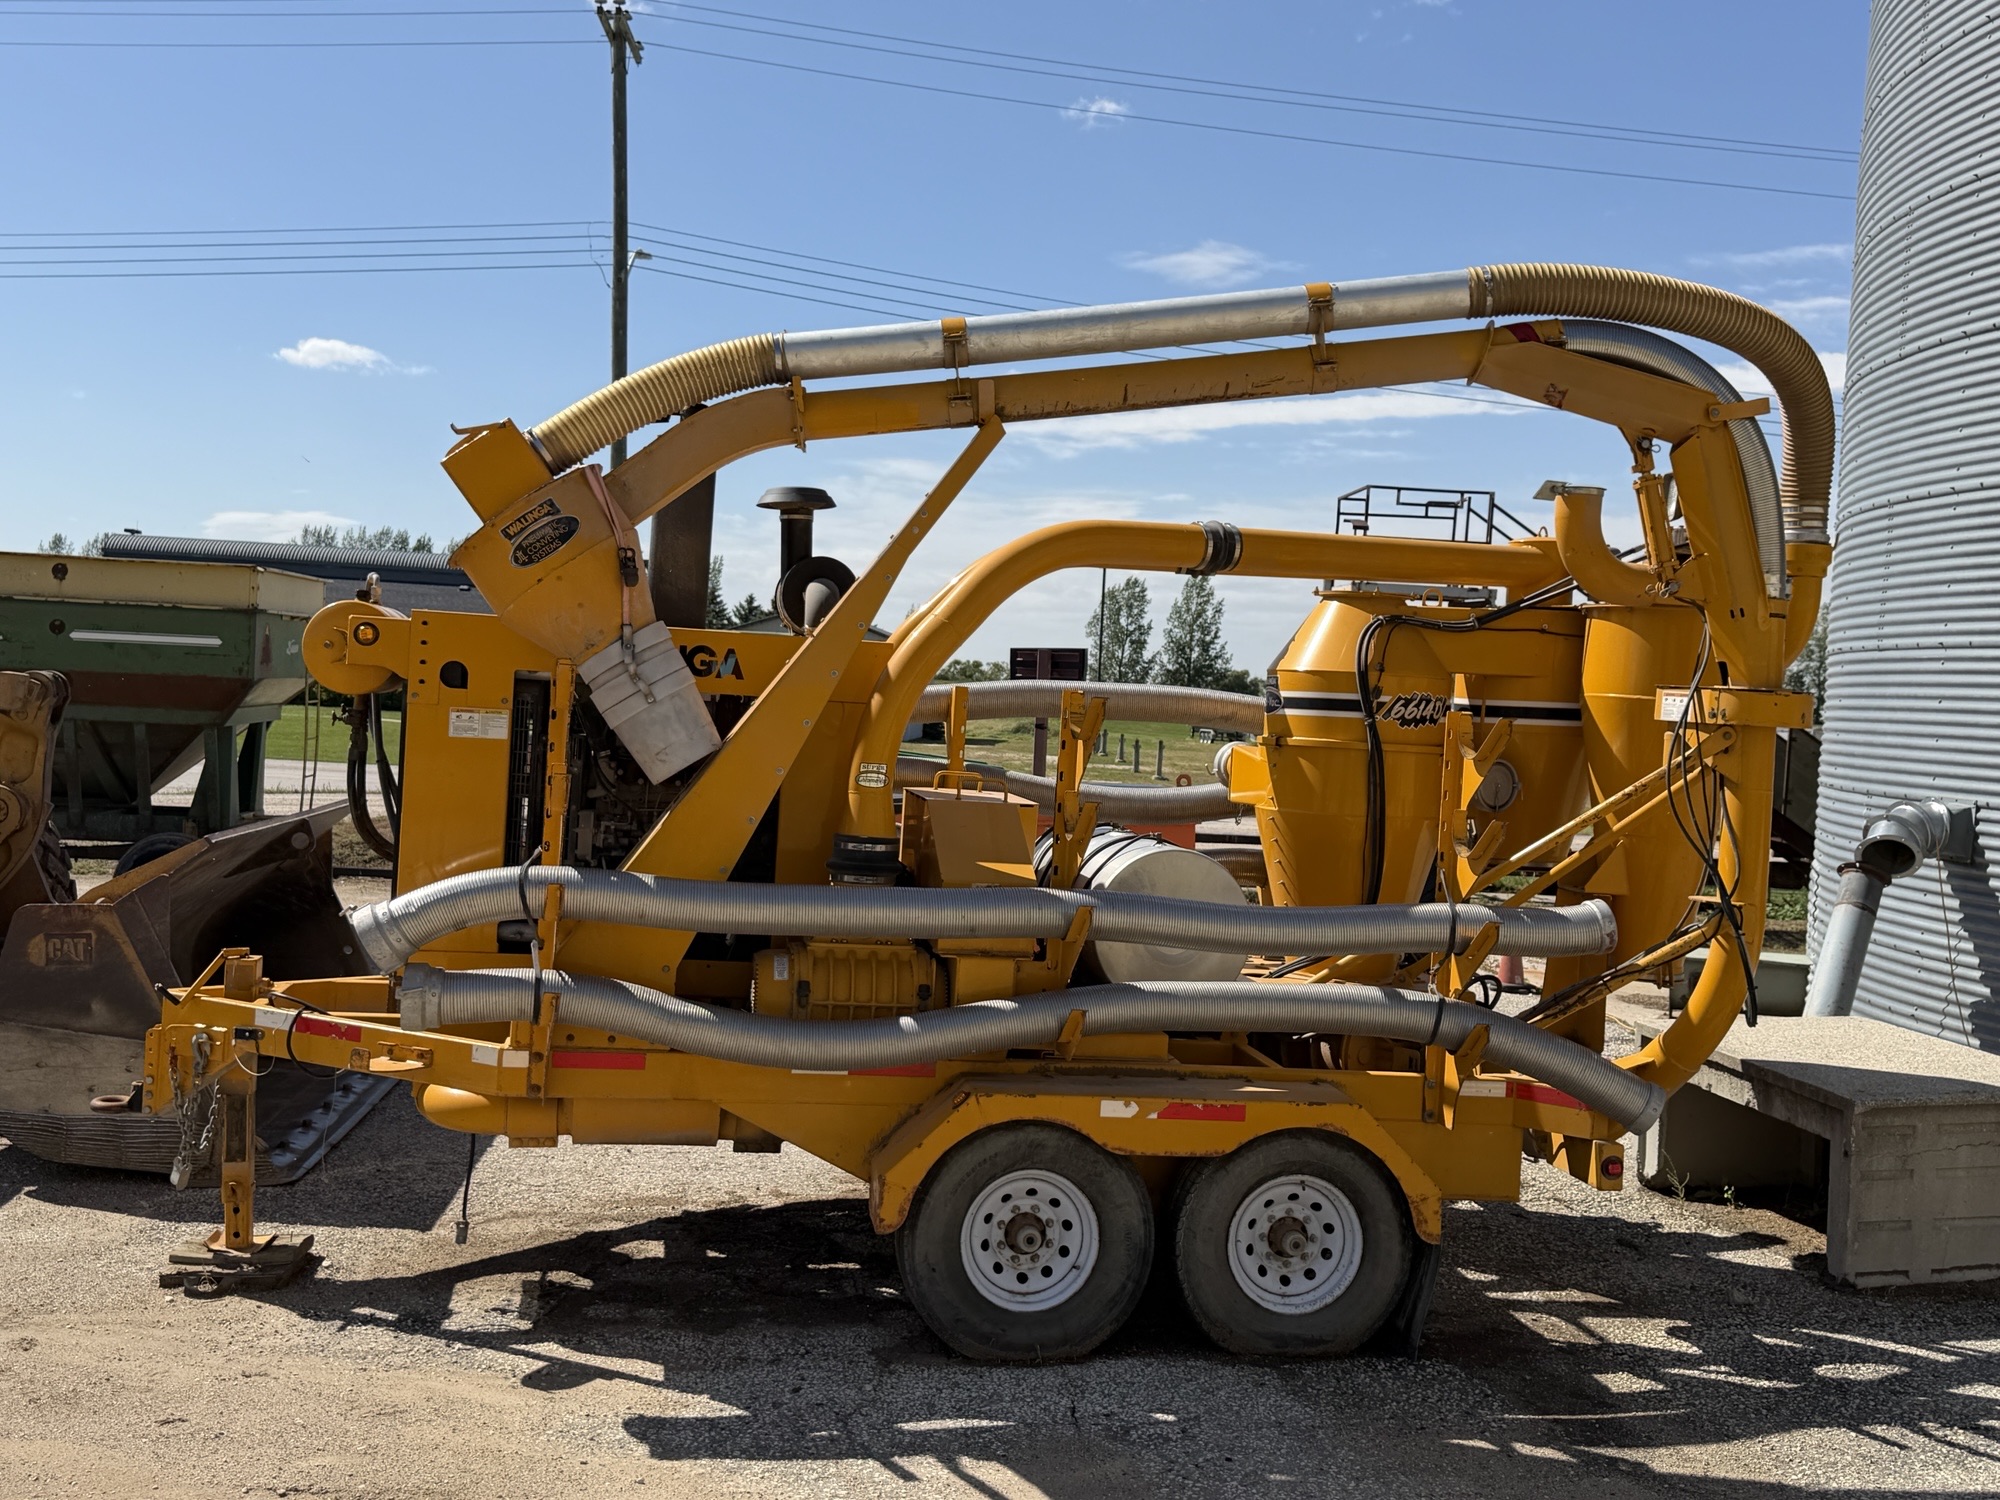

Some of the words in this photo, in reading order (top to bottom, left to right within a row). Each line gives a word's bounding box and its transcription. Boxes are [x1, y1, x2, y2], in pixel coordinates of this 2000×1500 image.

[505, 503, 553, 536] WALINGA
[522, 519, 562, 548] PNEUMATIC
[527, 524, 569, 555] CONVEYING
[531, 538, 563, 562] SYSTEMS
[679, 644, 744, 680] GA
[47, 938, 86, 961] CAT
